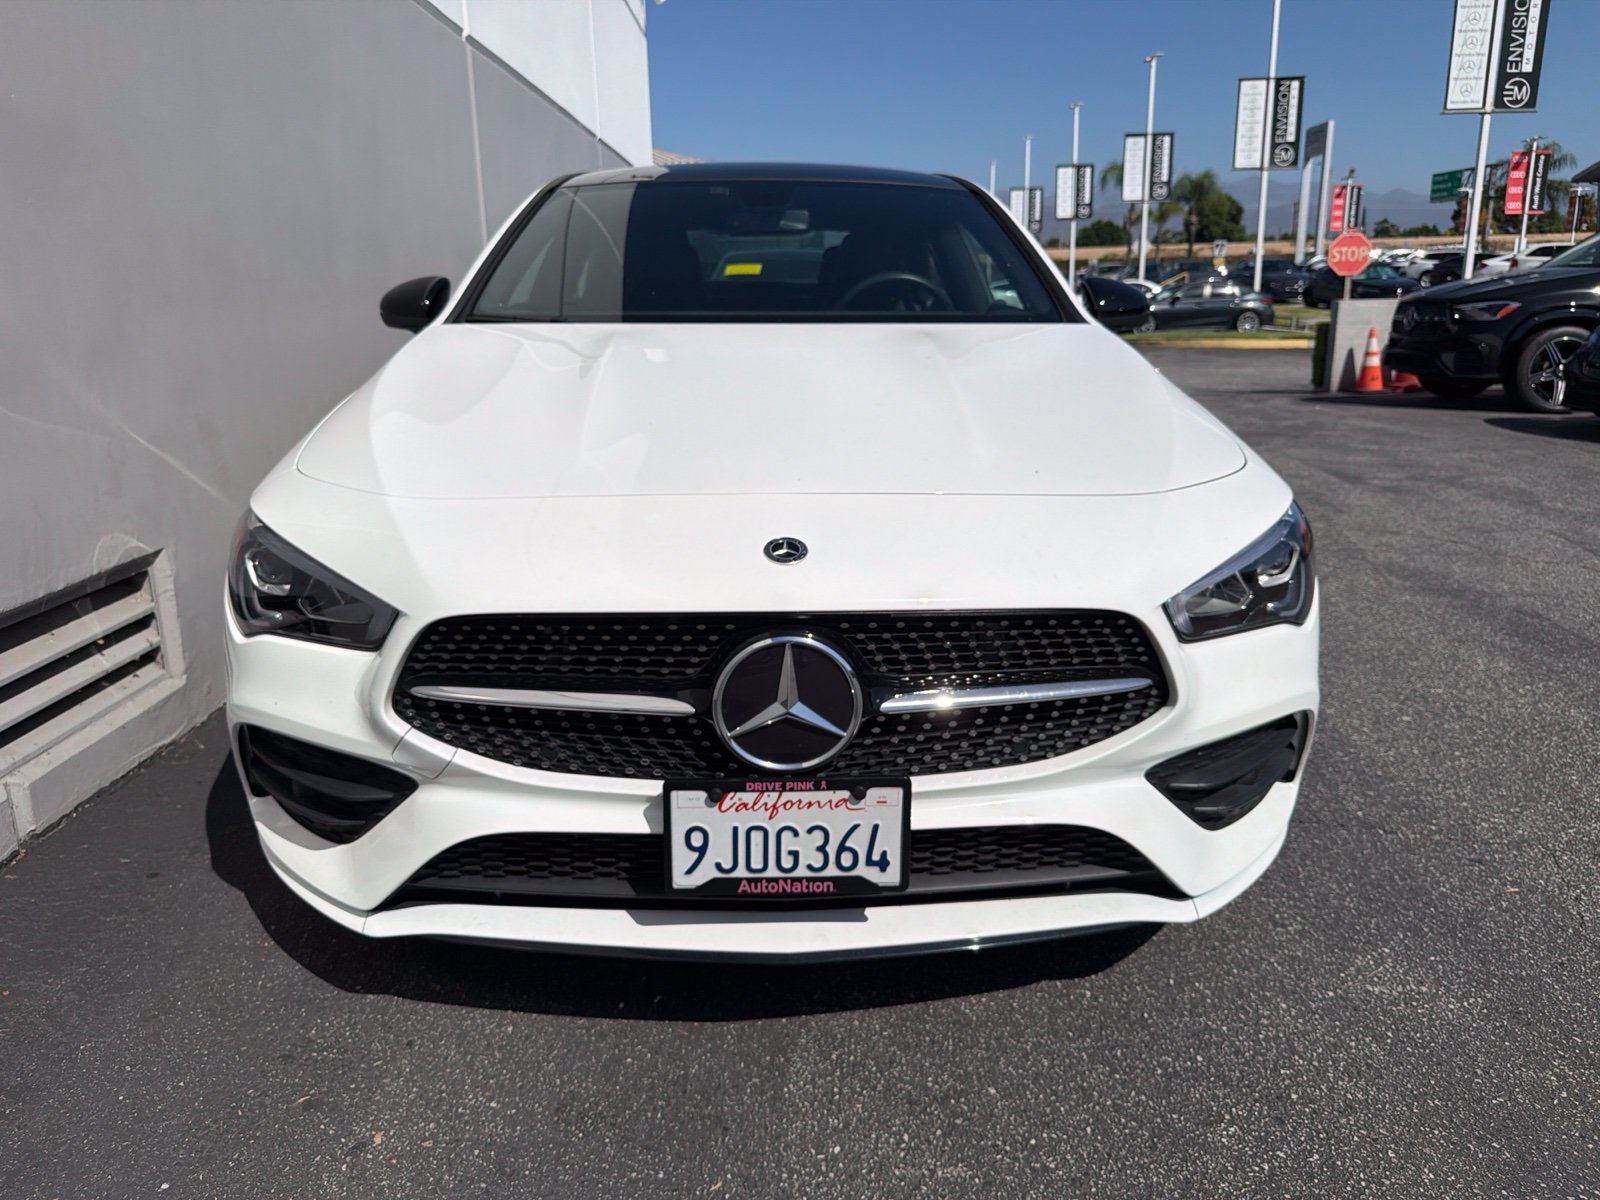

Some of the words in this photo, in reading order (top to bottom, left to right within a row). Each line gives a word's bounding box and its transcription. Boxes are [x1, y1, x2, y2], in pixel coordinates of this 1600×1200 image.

[1274, 80, 1291, 143] ENVISION
[1332, 245, 1369, 263] STOP
[746, 782, 783, 791] DRIVE
[786, 781, 815, 791] PINK
[716, 791, 867, 821] California
[684, 823, 891, 875] 9JOG364
[737, 879, 835, 894] AutoNation
